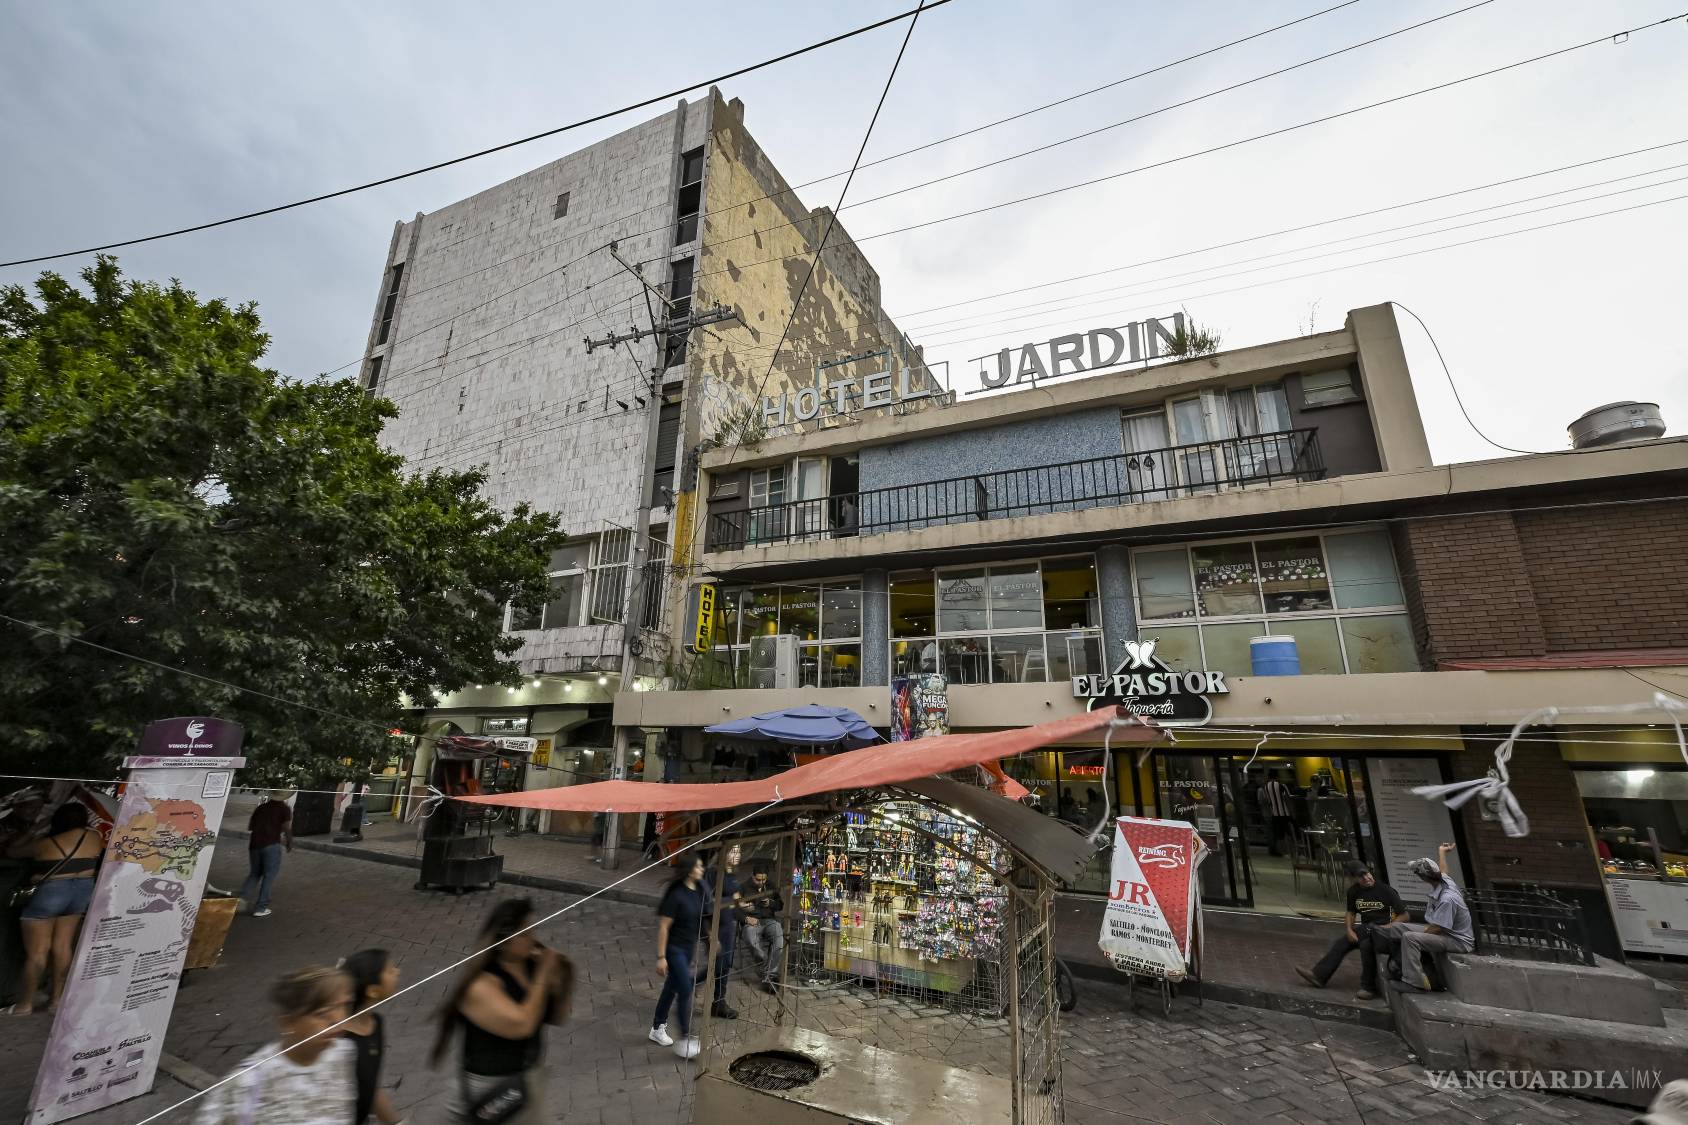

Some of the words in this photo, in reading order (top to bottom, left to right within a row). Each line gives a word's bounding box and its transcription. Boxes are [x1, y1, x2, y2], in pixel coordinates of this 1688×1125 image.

[762, 367, 931, 427] HOTEL
[980, 312, 1185, 388] JARDIN
[1213, 562, 1252, 573] PASTOR
[1261, 561, 1275, 569] EL
[1278, 557, 1320, 567] PASTOR
[1006, 582, 1037, 591] PASTOR
[791, 601, 816, 609] PASTOR
[698, 587, 714, 650] HOTEL
[1071, 674, 1107, 698] EL
[1111, 670, 1230, 697] PASTOR
[922, 694, 947, 703] MEGA
[1069, 764, 1107, 776] ABIERTO
[1021, 778, 1052, 786] PASTOR
[1159, 780, 1171, 788] EL
[1174, 780, 1210, 788] PASTOR
[1107, 879, 1151, 907] JR
[1109, 919, 1135, 931] SALTILLO
[1111, 929, 1131, 940] RAMOS
[1121, 959, 1142, 969] PAGA
